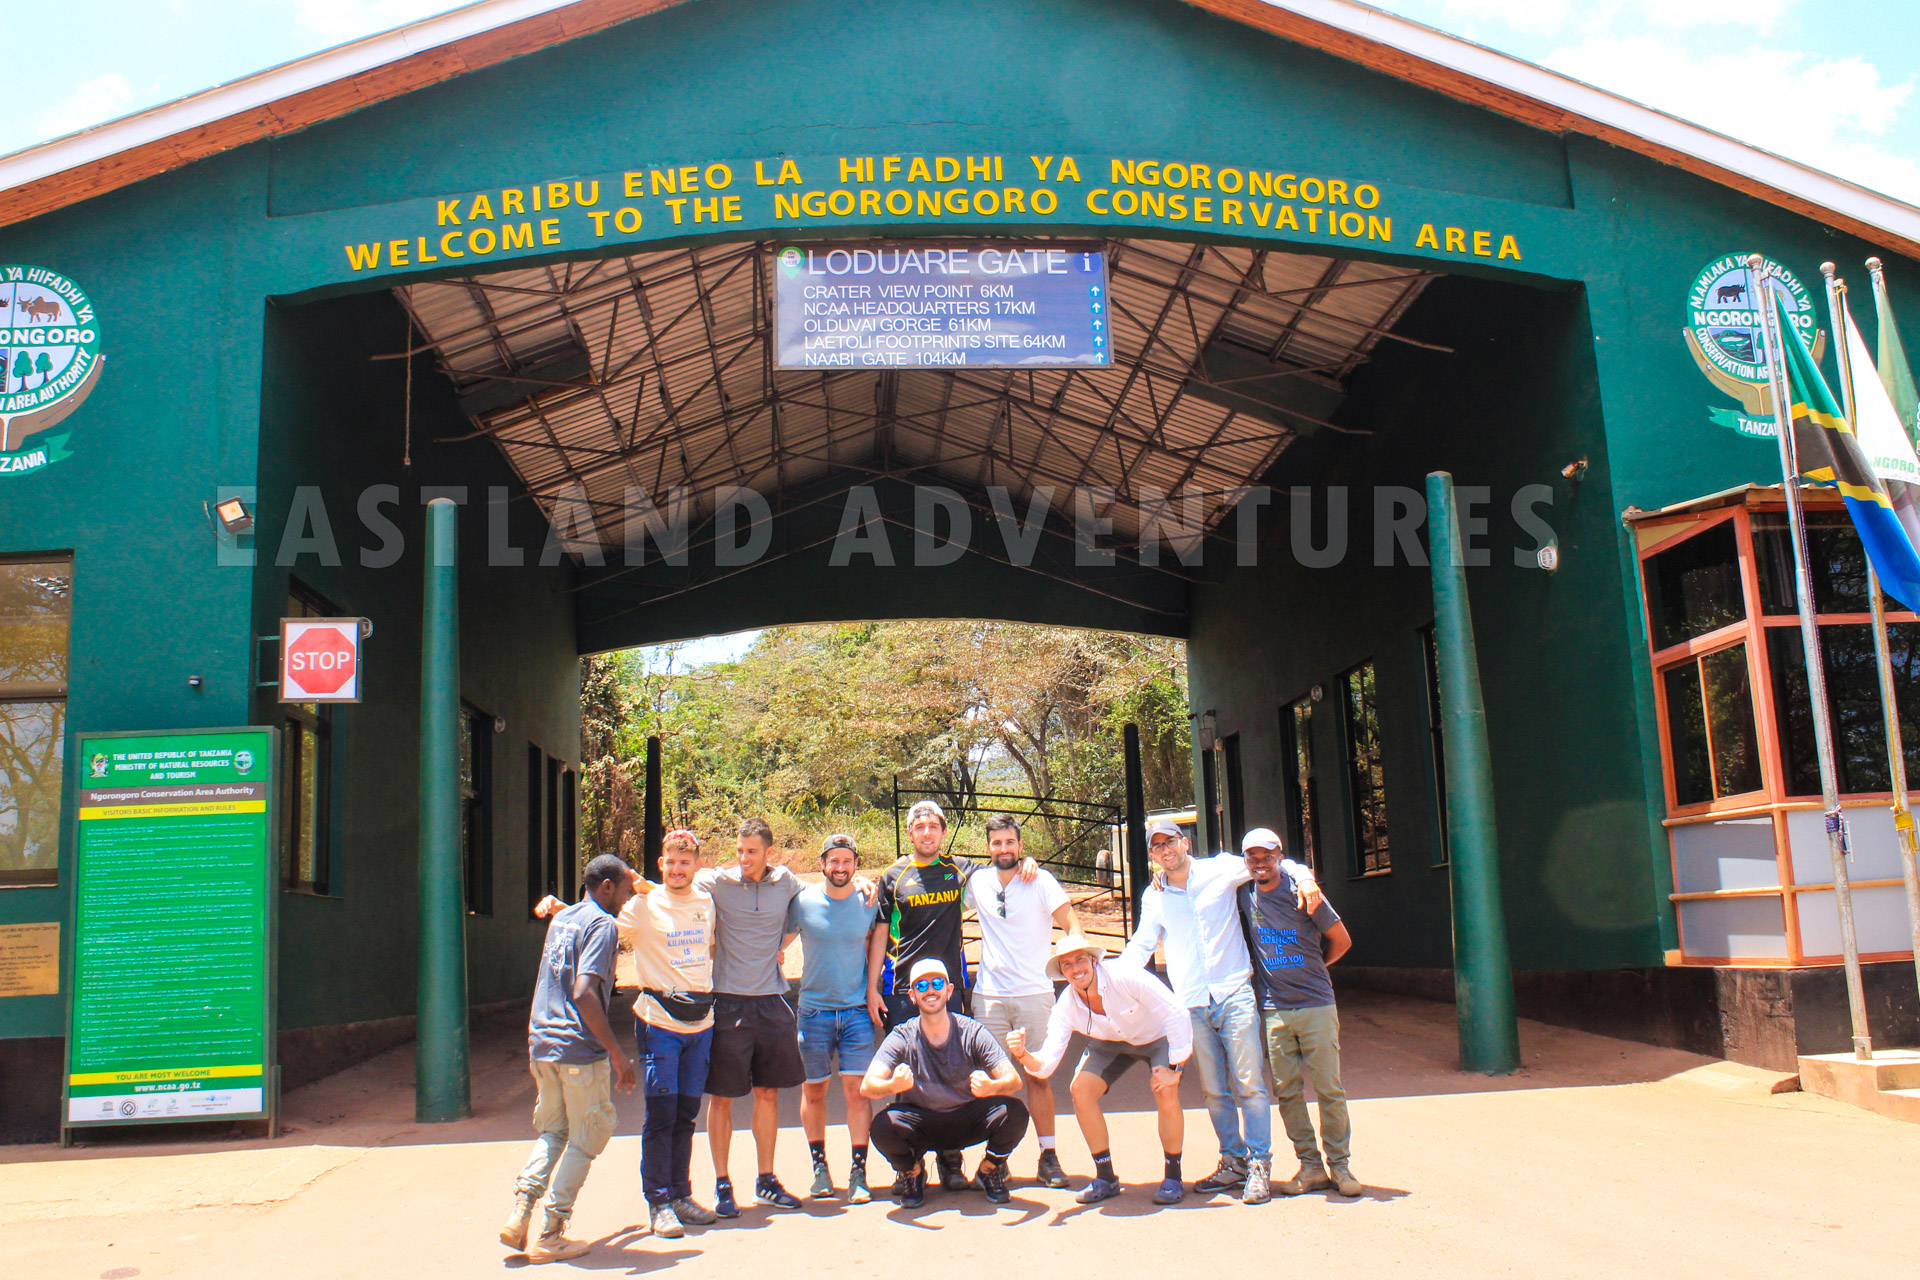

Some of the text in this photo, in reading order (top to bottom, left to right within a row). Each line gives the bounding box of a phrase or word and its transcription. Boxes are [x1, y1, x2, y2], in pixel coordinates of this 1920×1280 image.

[437, 155, 1380, 227] KARIBU ENEO LA HIFADHI YA NGORONGORO
[345, 188, 1522, 271] WELCOME TO THE NGORONGORO CONSERVATION AREA
[808, 249, 1069, 275] LODUARE GATE
[6, 267, 23, 281] YA
[1690, 255, 1811, 312] MAMLAKA YA IFADHI YA
[26, 267, 86, 305] HIFADHI
[77, 303, 94, 325] YA
[803, 285, 1014, 299] CRATER VIEW POINT 6KM
[804, 301, 1036, 316] NCAA HEADQUARTERS 17KM
[804, 318, 991, 333] OLDUVAI GORGE 61KM
[1693, 311, 1813, 329] NGORONRO
[804, 335, 1066, 350] LAETOLI FOOTPRINTS SITE 64KM
[805, 352, 966, 366] NAABI GATE 104KM
[1696, 327, 1756, 379] CONSERVATION
[6, 347, 92, 412] AREA AUTHORITY
[1737, 418, 1778, 436] TANZA
[1869, 456, 1915, 473] NGORO
[291, 651, 351, 671] STOP
[113, 749, 233, 761] THE UNITED REPUBLIC OF TANZANIA
[114, 759, 230, 771] MINISTRY OF NATURAL RESOURCES
[150, 771, 196, 780] AND TOURISM
[91, 787, 255, 802] Ngorongoro Conservation Area Authority
[103, 808, 132, 816] VISITORS
[133, 807, 152, 815] BASIC
[154, 805, 199, 814] INFORMATION
[216, 804, 236, 812] RULES
[683, 948, 690, 956] IS
[1275, 944, 1285, 955] IS
[1288, 954, 1305, 964] YOU
[115, 1069, 211, 1081] YOU ARE MOST WELCOME
[134, 1081, 201, 1093] www.ncaa.go.tz
